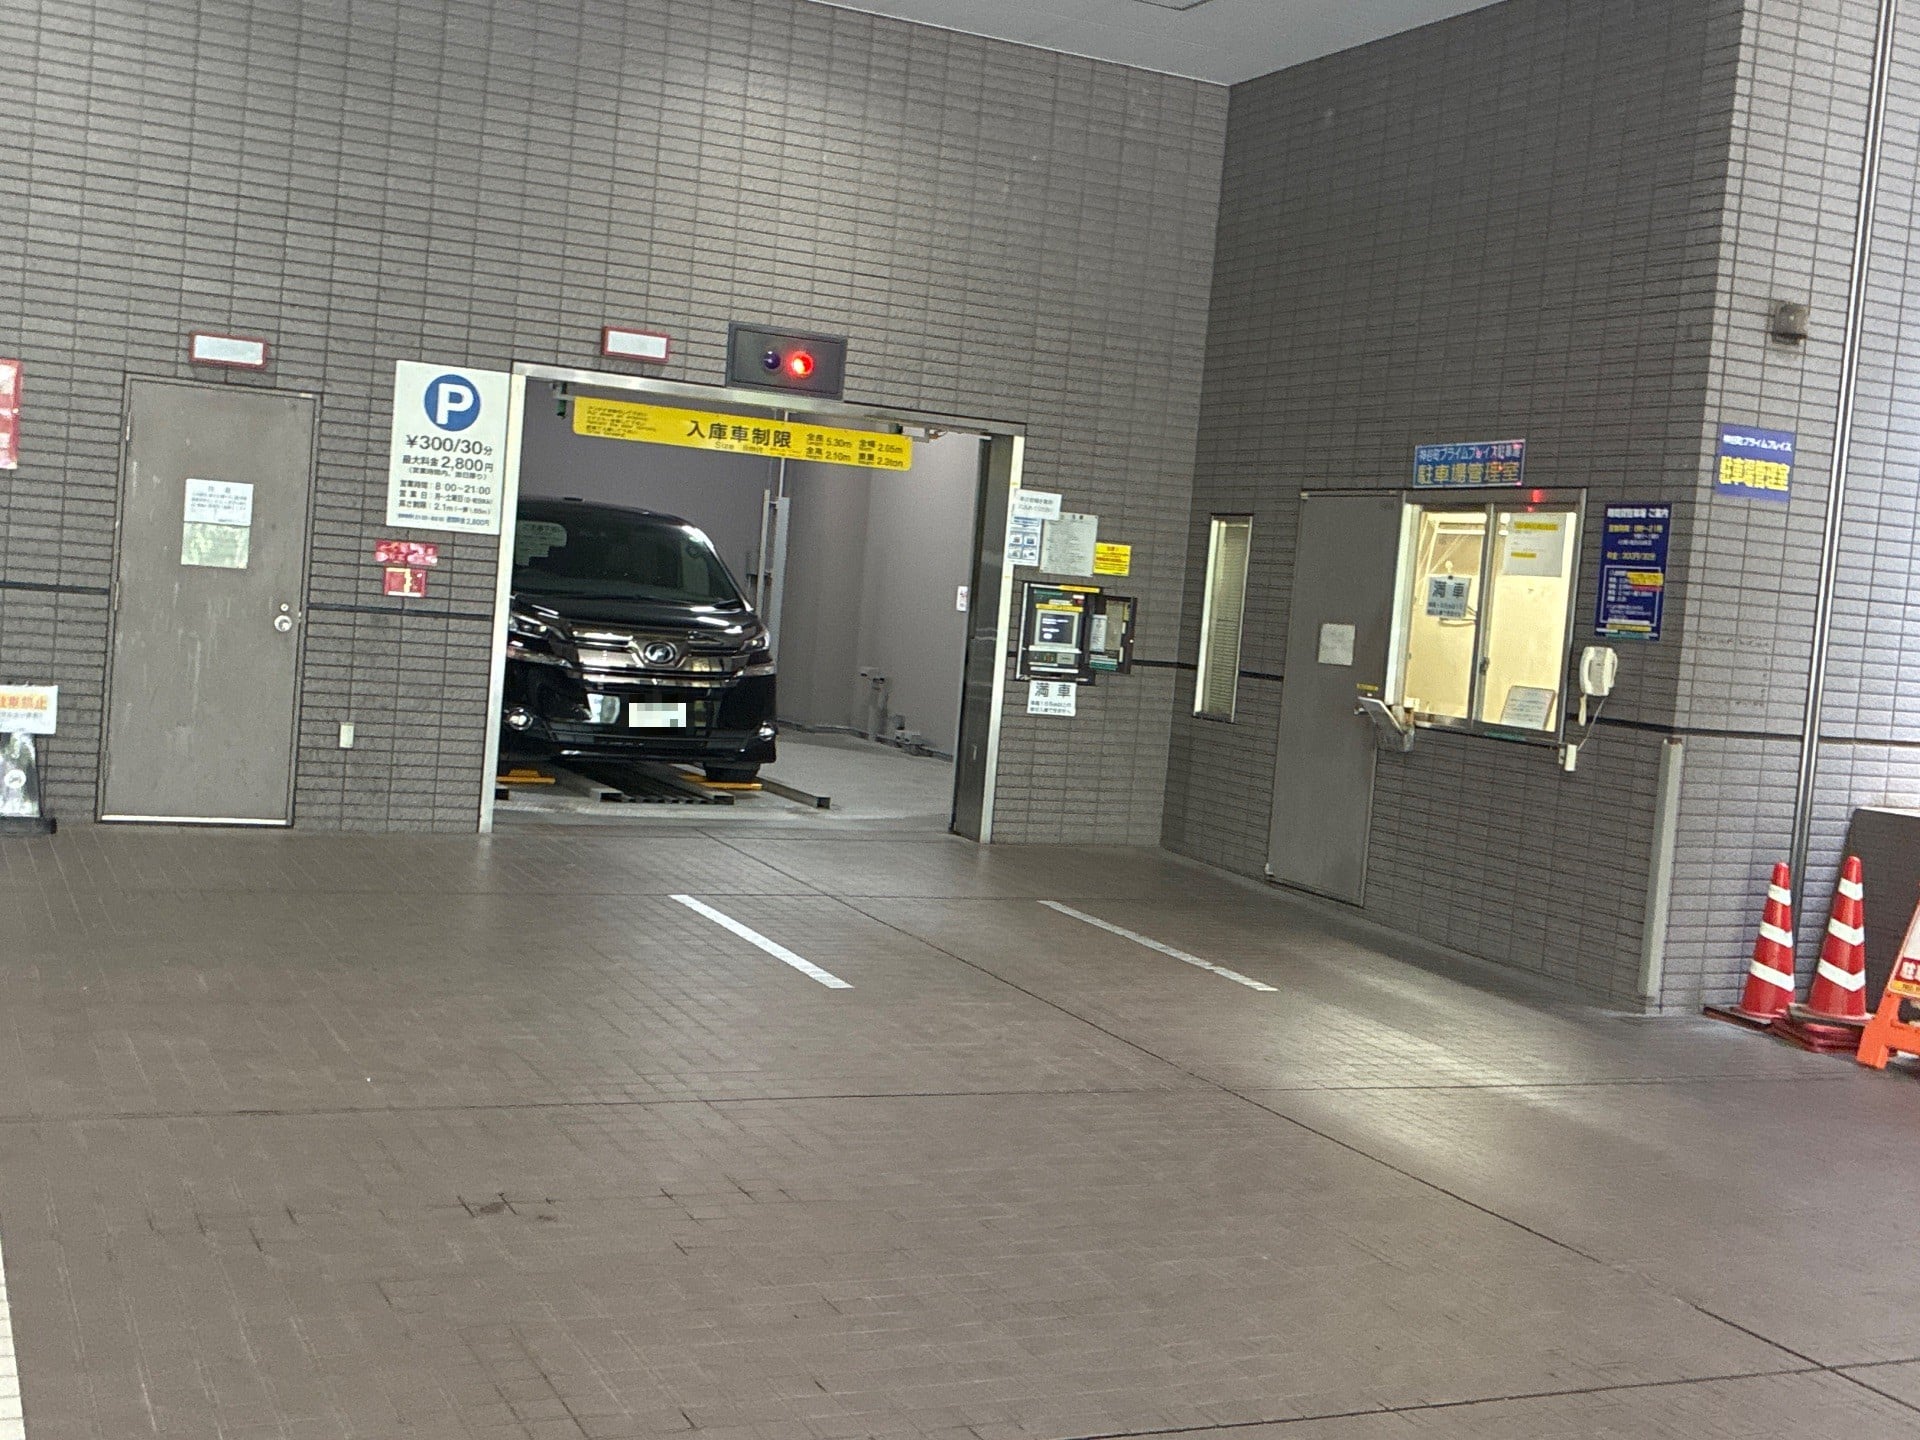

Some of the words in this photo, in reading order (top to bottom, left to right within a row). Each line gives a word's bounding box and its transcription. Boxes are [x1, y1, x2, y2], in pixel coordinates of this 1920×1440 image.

[435, 382, 474, 425] P
[687, 420, 792, 448] 入庫車制限
[826, 437, 852, 448] 5.30m
[825, 451, 851, 461] 2.10m
[1034, 682, 1071, 698] 満車
